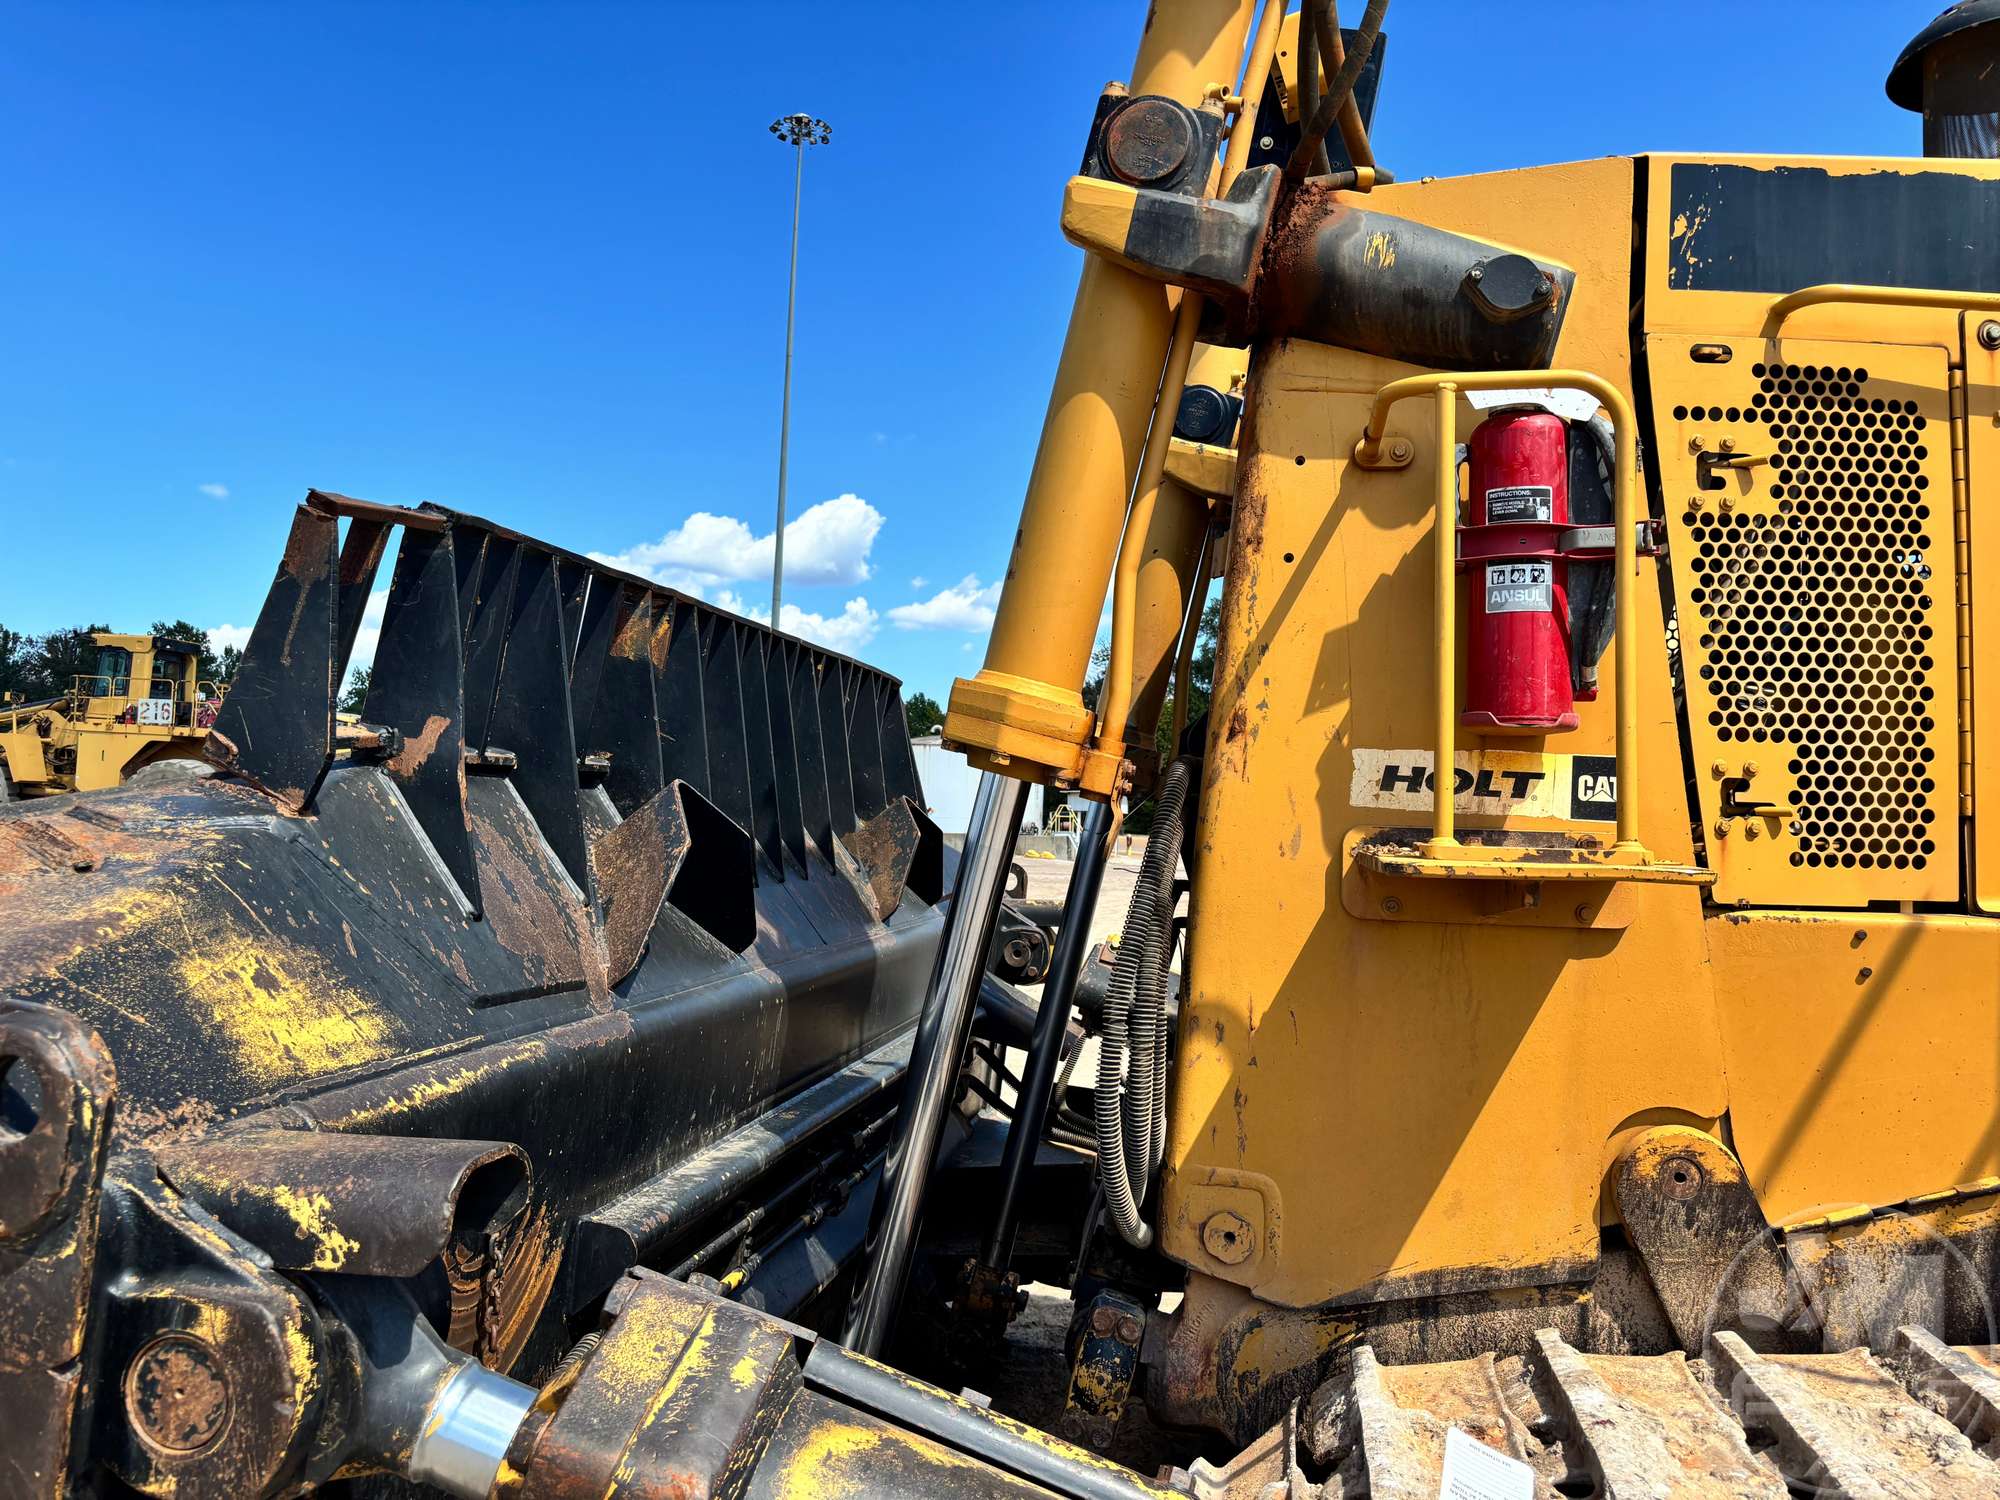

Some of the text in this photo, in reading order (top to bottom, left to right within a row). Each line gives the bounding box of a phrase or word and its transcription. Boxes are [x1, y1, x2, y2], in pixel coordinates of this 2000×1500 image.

[1490, 588, 1544, 604] ANSUL
[139, 701, 171, 721] 216
[1379, 764, 1546, 799] HOLT
